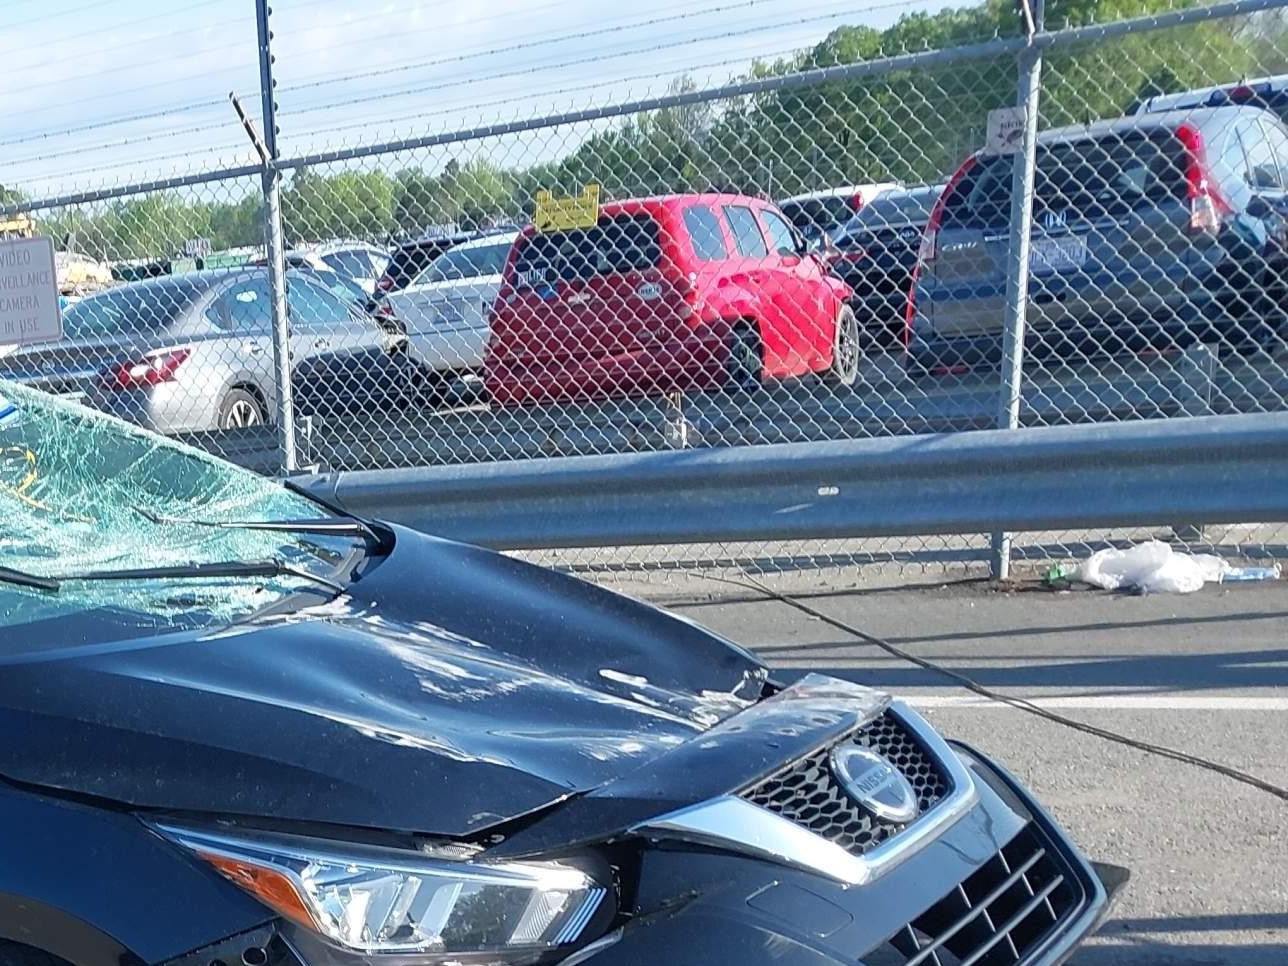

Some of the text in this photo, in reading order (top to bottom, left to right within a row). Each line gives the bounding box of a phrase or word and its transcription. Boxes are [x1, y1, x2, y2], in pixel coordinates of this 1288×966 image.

[0, 295, 40, 313] CAMERA
[4, 318, 40, 335] IN USE
